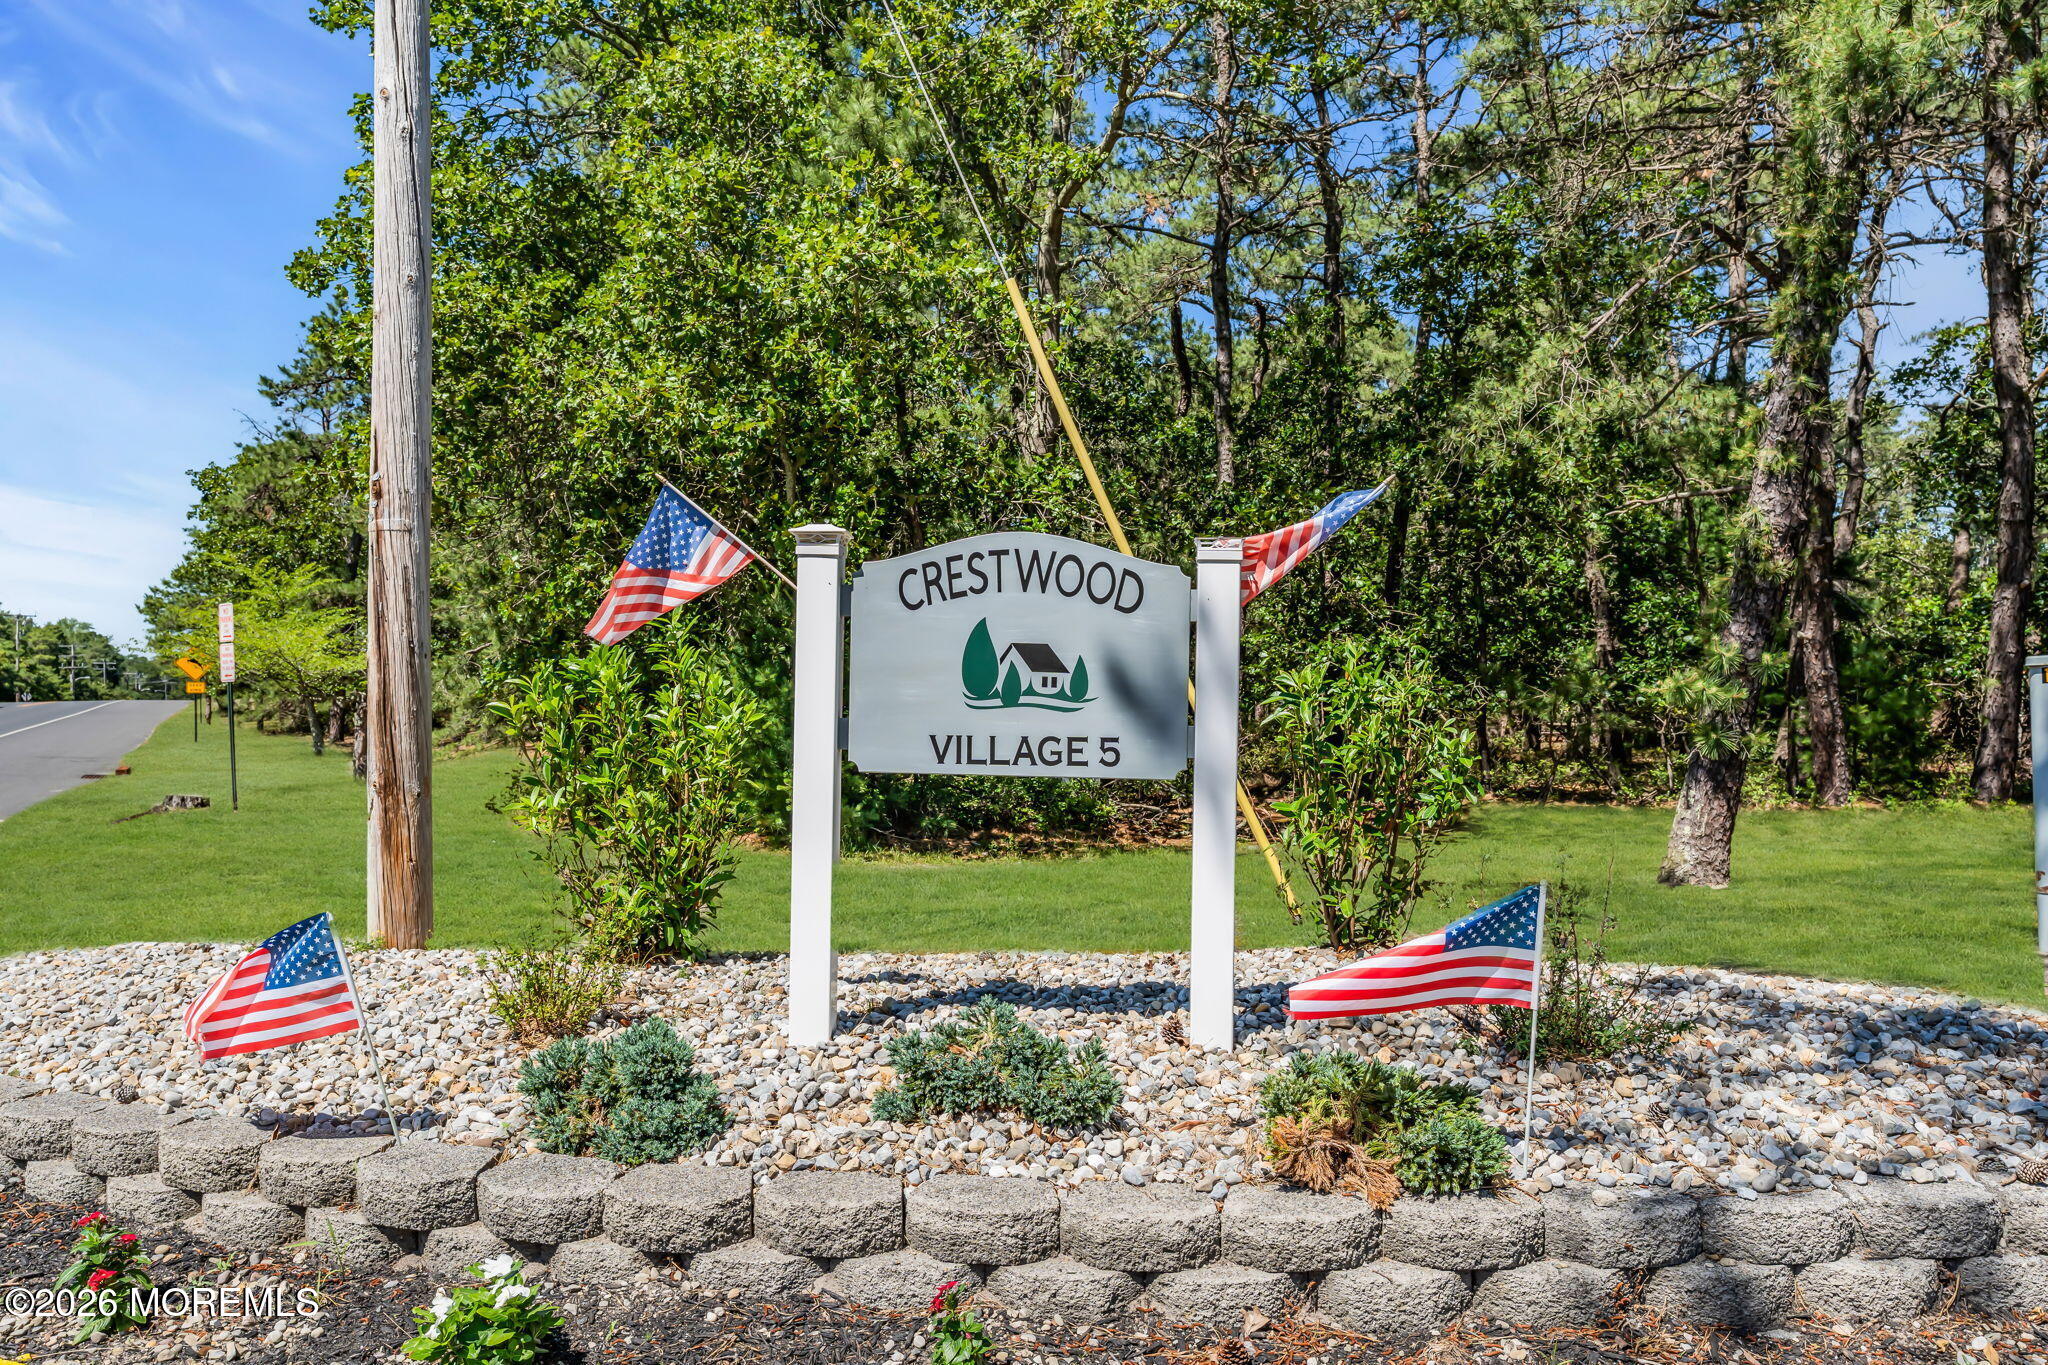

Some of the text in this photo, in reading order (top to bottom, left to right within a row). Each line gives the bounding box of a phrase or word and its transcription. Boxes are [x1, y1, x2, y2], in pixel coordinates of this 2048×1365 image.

[898, 548, 1145, 614] CRESTWOOD
[928, 734, 1121, 767] VILLAGE 5
